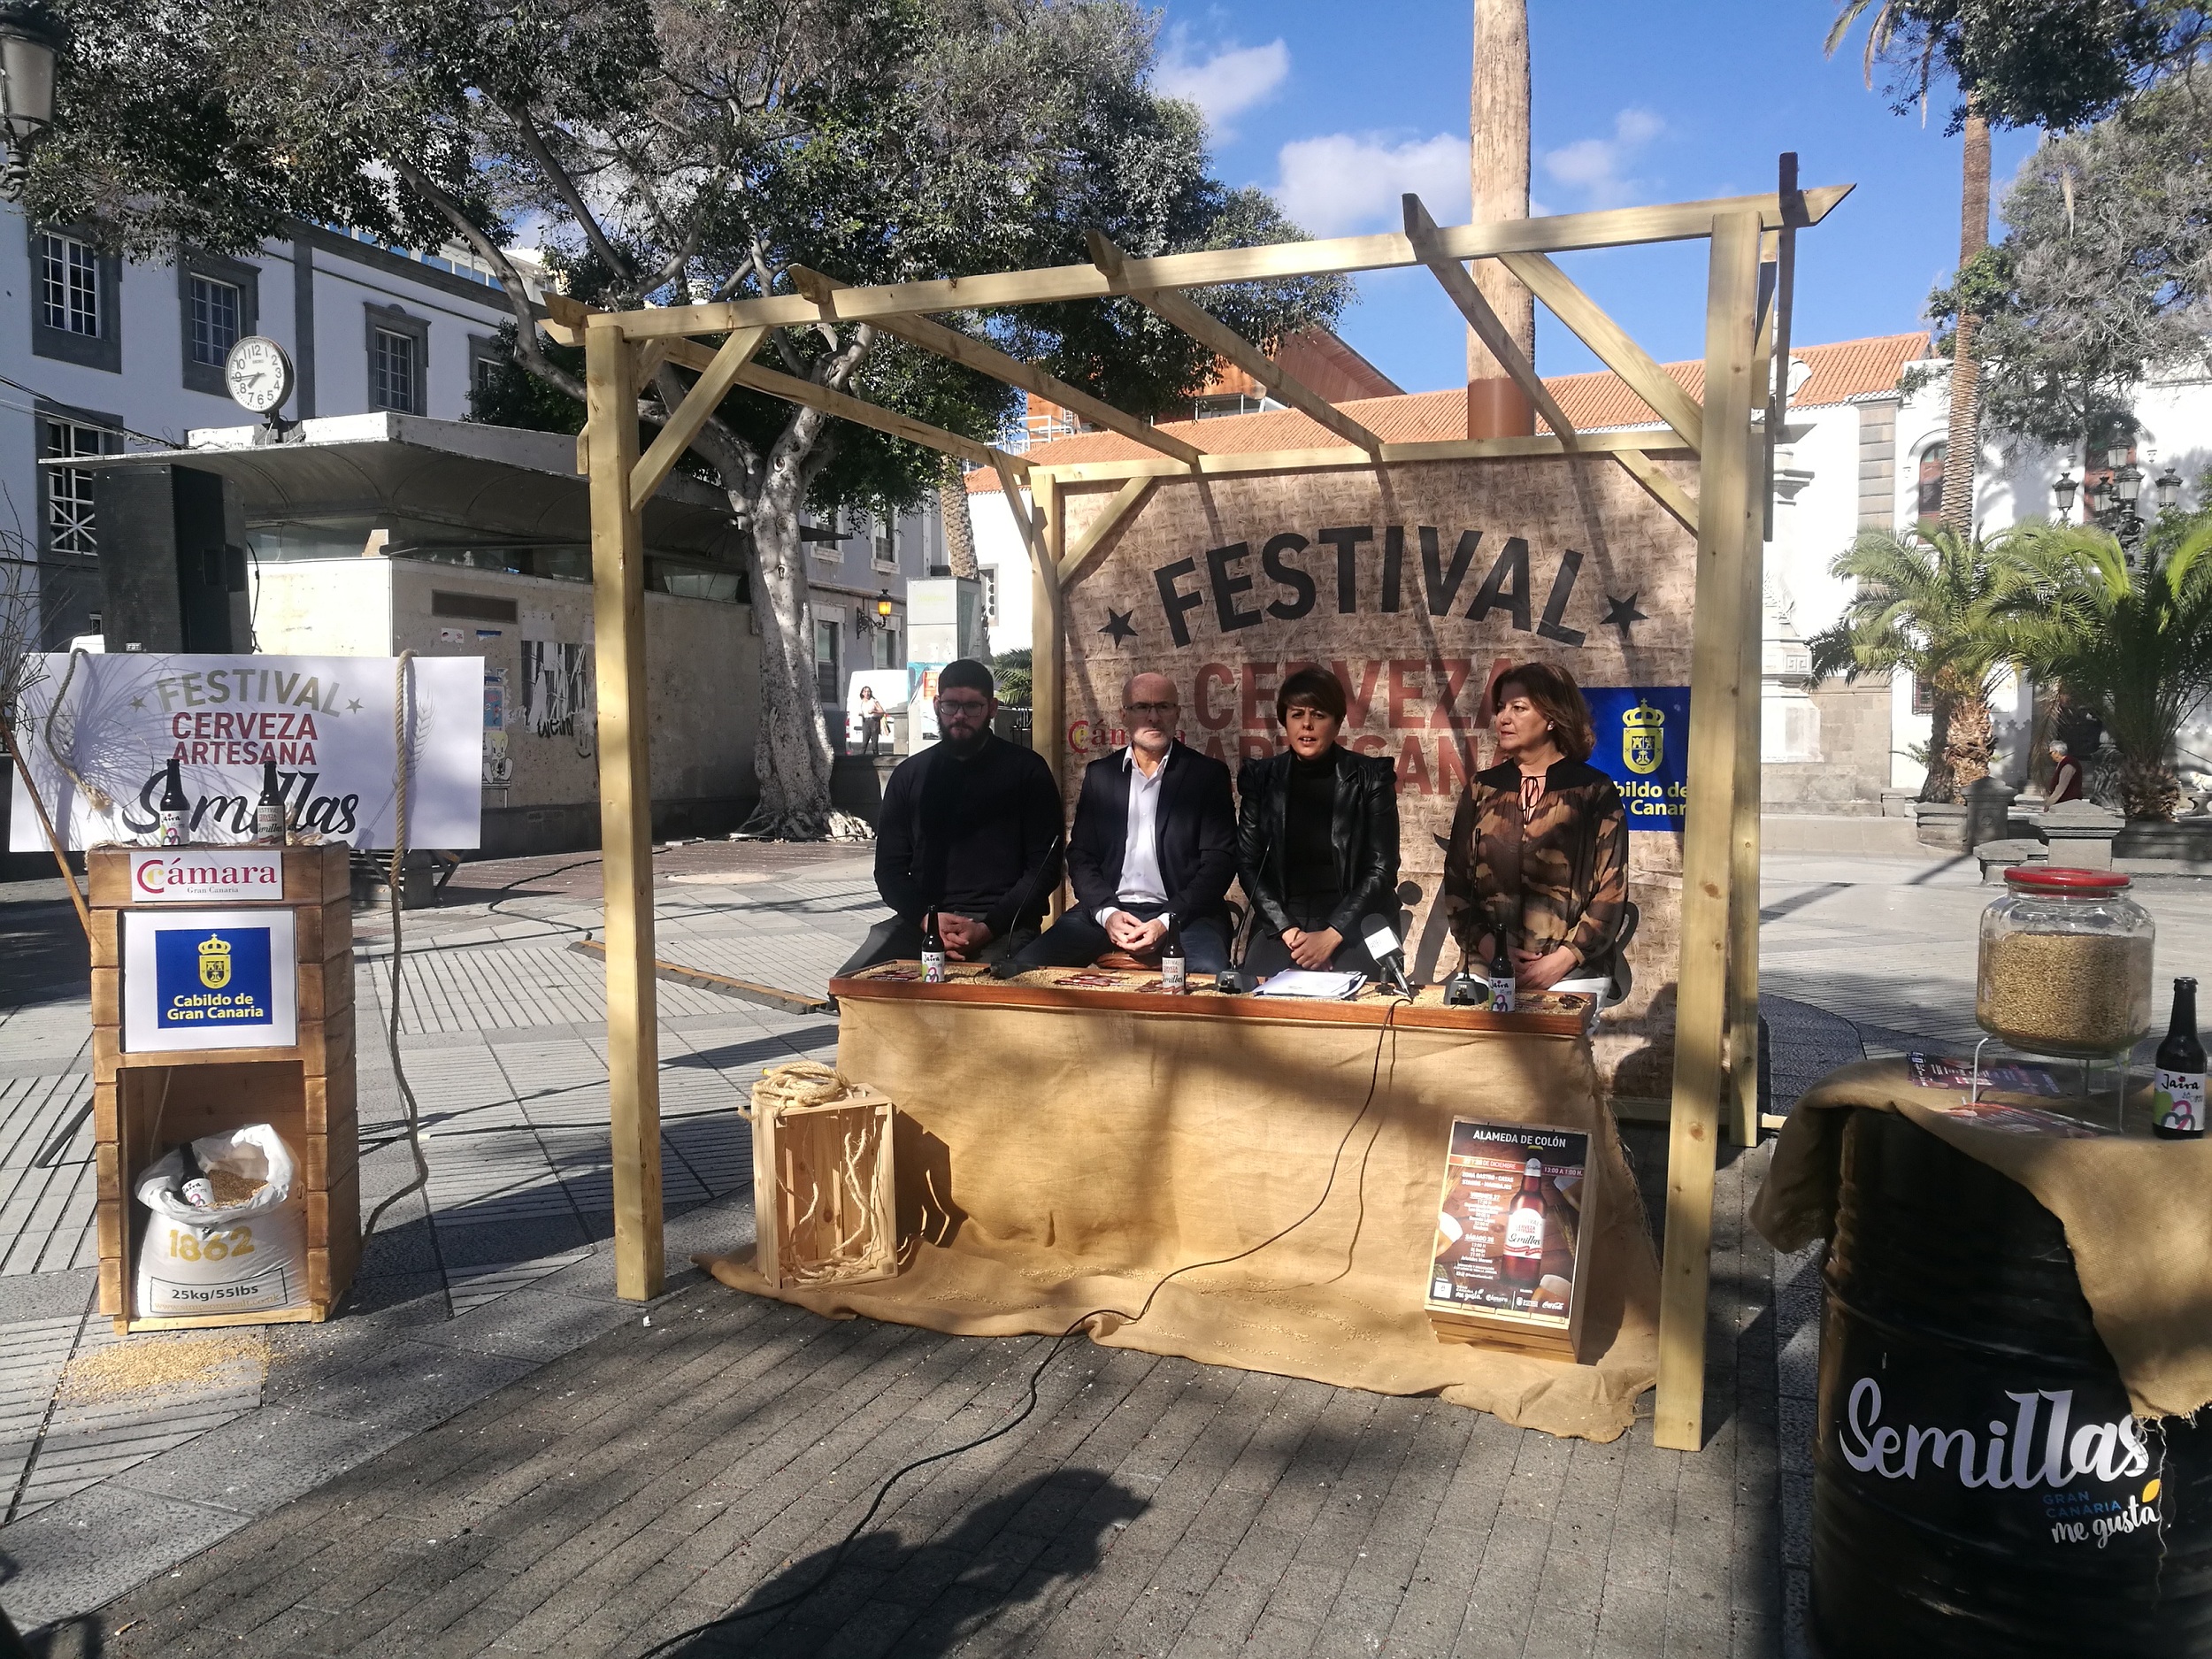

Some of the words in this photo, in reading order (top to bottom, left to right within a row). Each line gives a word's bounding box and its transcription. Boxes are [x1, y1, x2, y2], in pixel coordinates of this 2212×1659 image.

[251, 344, 262, 356] 12
[235, 358, 246, 371] 10
[271, 354, 279, 365] 2
[275, 367, 282, 379] 3
[239, 382, 247, 395] 8
[273, 380, 280, 391] 4
[248, 392, 255, 403] 7
[257, 394, 265, 405] 6
[266, 389, 274, 402] 5
[1152, 525, 1589, 649] FESTIVAL
[156, 668, 342, 718] FESTIVAL
[172, 710, 319, 741] CERVEZA
[173, 741, 318, 766] ARTESANA
[136, 857, 279, 894] Cámara
[173, 993, 231, 1008] Cabildo
[234, 993, 254, 1006] de
[167, 1008, 204, 1021] Gran
[206, 1005, 265, 1019] Canaria
[2161, 1073, 2200, 1090] Jaira
[1472, 1129, 1519, 1144] ALAMEDA
[1520, 1134, 1532, 1145] DE
[1534, 1135, 1567, 1148] COLÓN
[1490, 1160, 1517, 1170] DICIEMBRE
[169, 1225, 256, 1263] 1862
[154, 1294, 280, 1310] www.simpsonsmalt.co.uk
[172, 1286, 258, 1302] 25kg/55lbs
[1839, 1376, 2151, 1490] Semillas
[2043, 1490, 2090, 1505] GRAN
[2045, 1499, 2123, 1519] CANARIA
[2050, 1520, 2090, 1545] me
[2092, 1494, 2162, 1549] gusta
